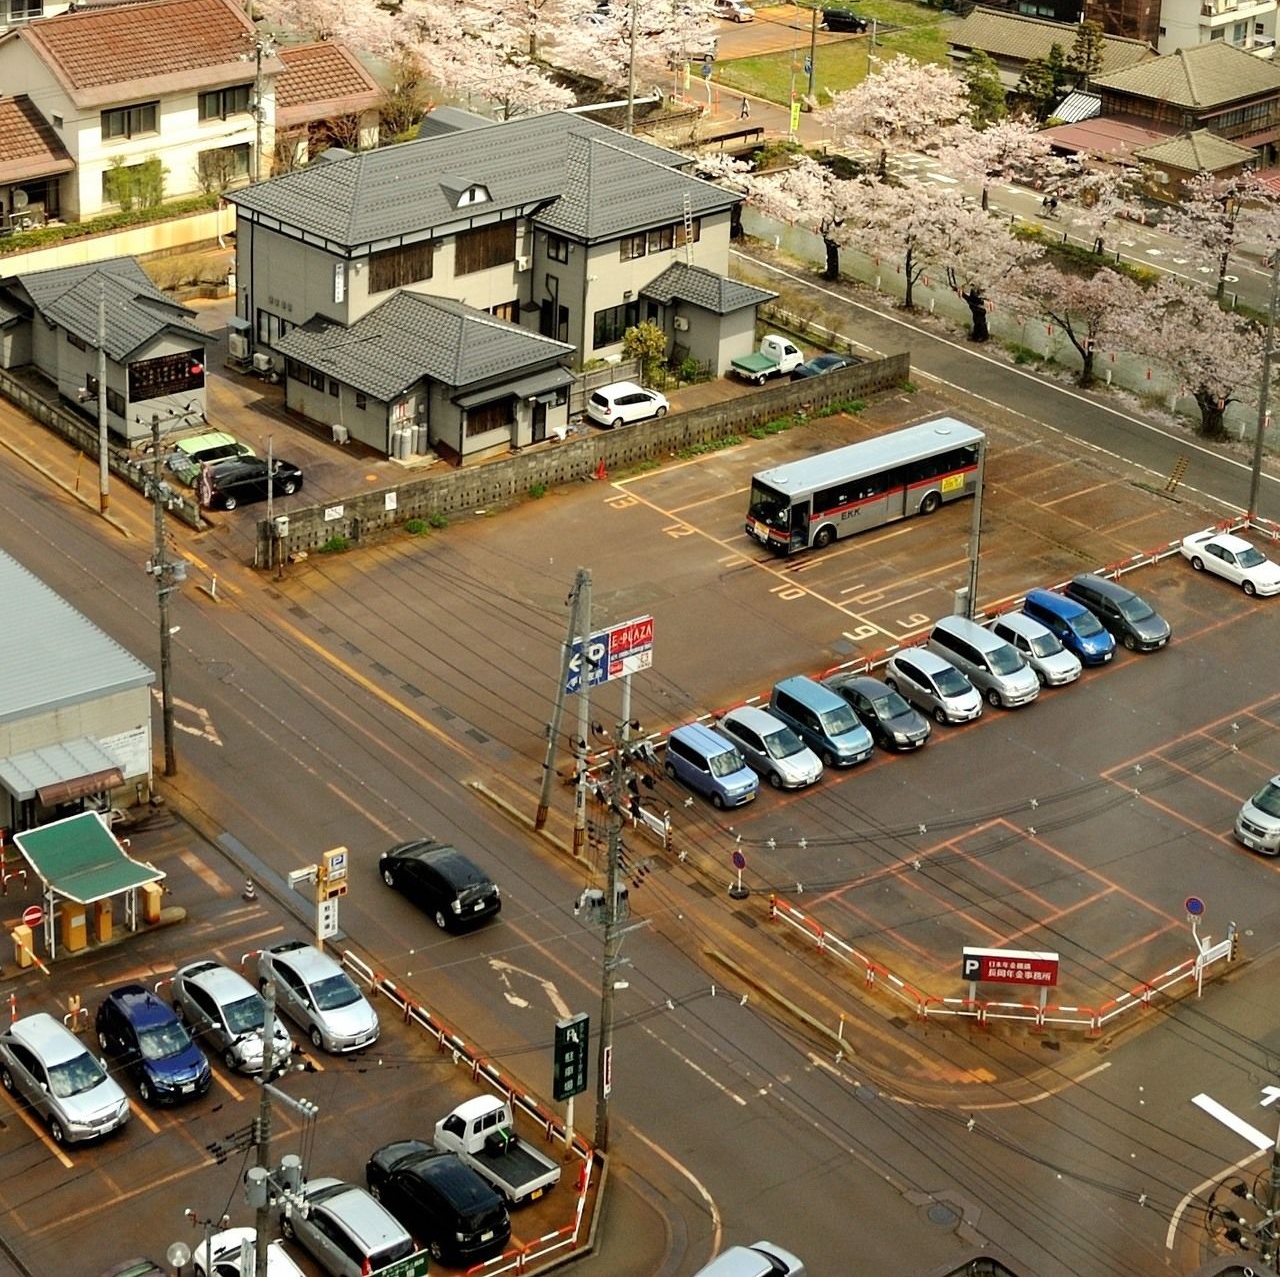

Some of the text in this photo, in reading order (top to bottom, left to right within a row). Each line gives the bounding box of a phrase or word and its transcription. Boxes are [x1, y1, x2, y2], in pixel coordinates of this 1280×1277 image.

[769, 584, 806, 600] 10
[843, 624, 879, 641] 9
[965, 959, 979, 975] P
[988, 968, 1052, 981] 長岡年金事務所
